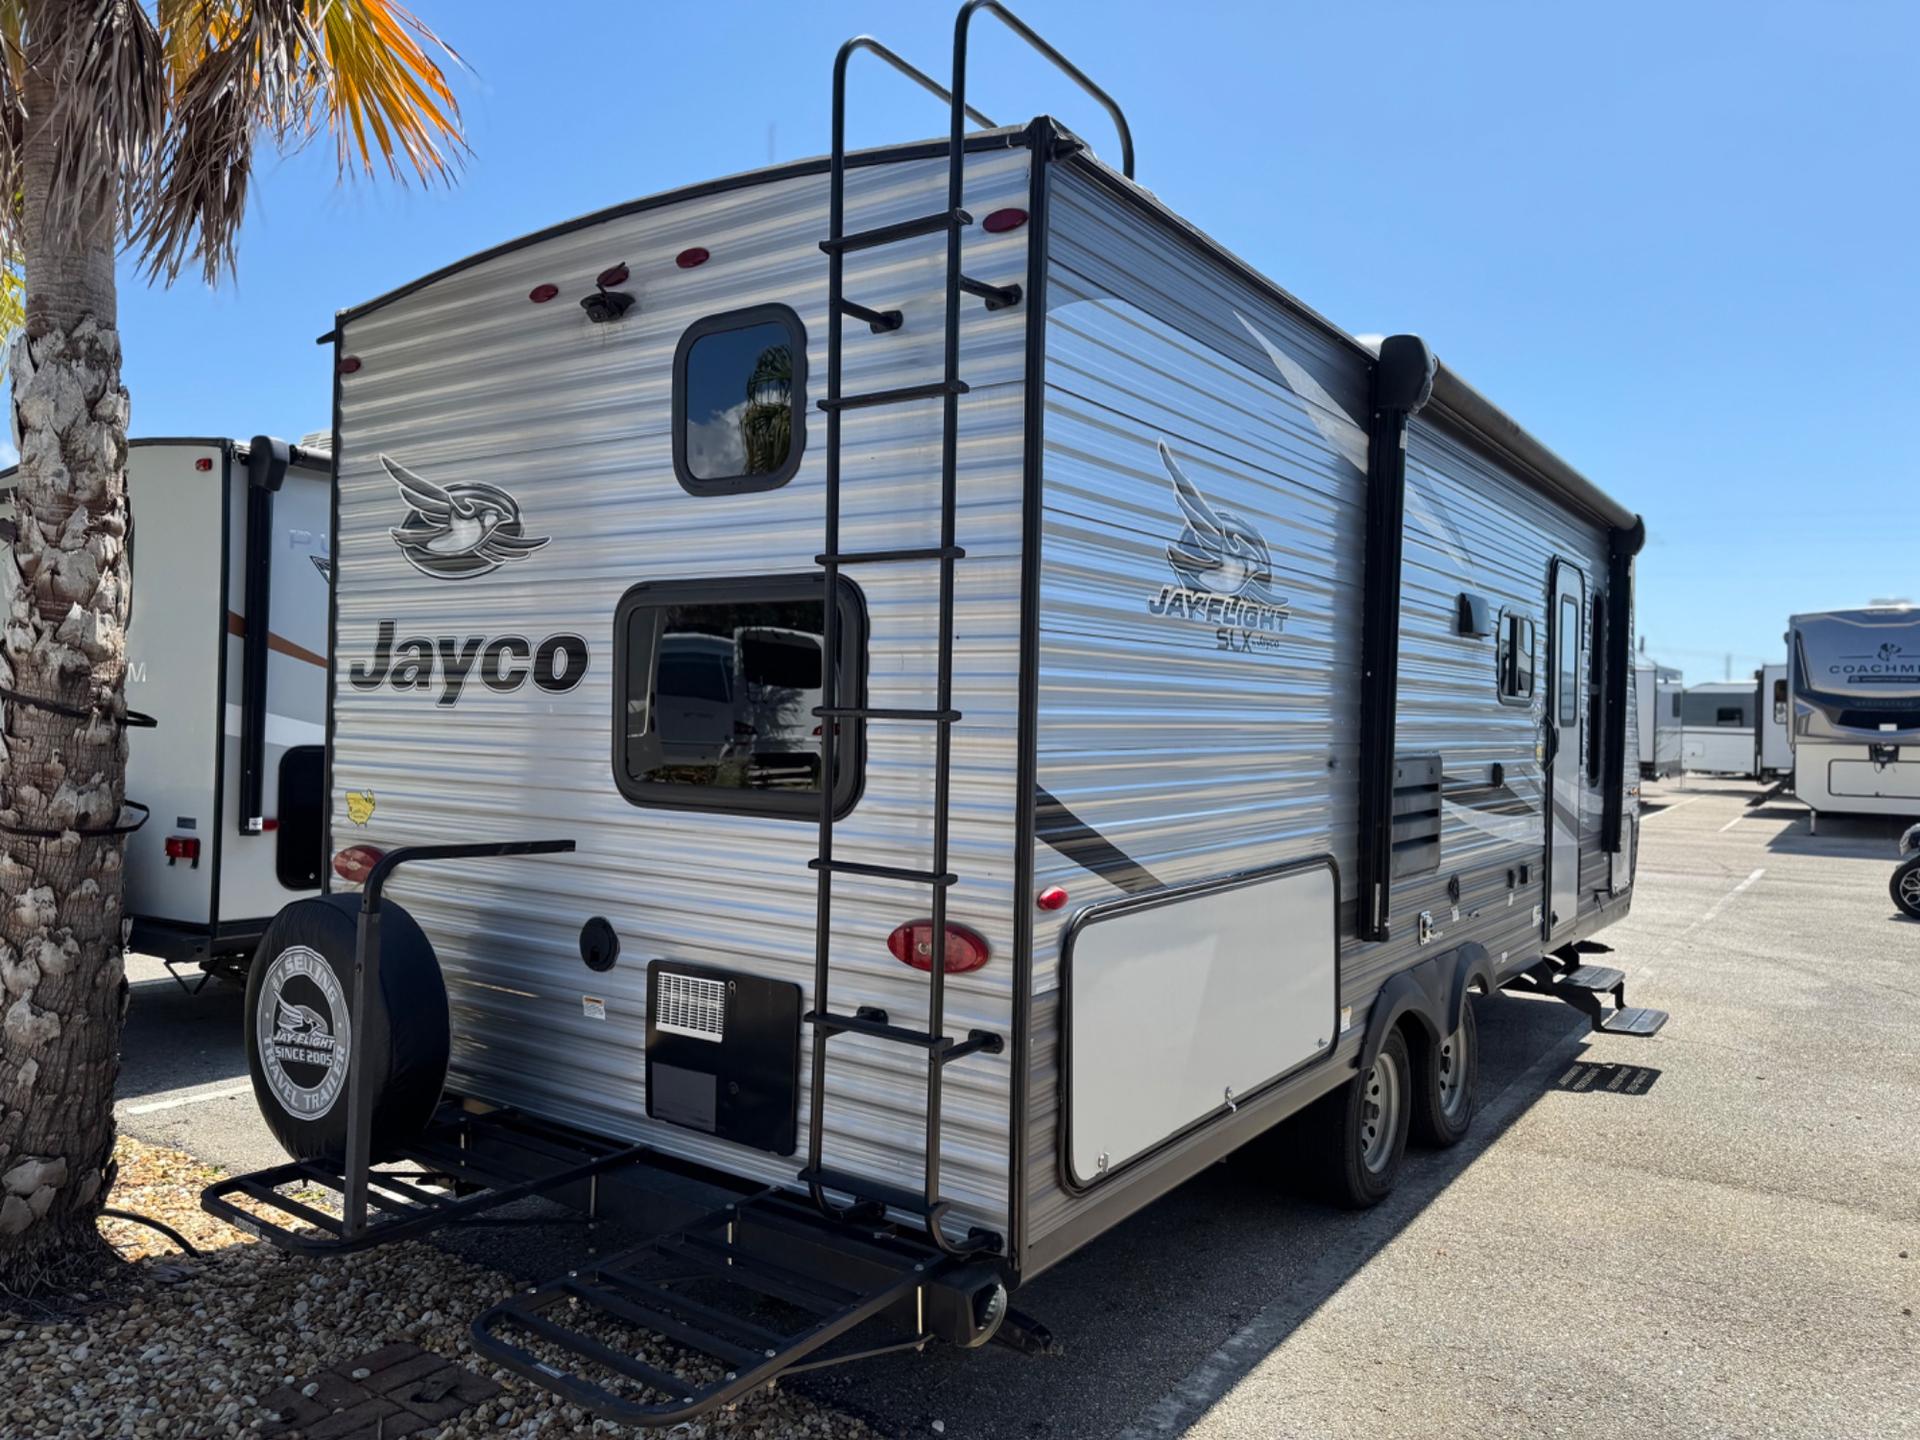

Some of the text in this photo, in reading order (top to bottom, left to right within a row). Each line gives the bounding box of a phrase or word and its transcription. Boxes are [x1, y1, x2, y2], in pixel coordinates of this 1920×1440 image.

[1215, 627, 1252, 653] SLX
[348, 618, 590, 708] Jayco
[1829, 664, 1920, 674] COACHM
[284, 956, 339, 1002] SELLING
[263, 1036, 346, 1110] TRAVEL TRAILER
[274, 1045, 333, 1066] SINCE 2005
